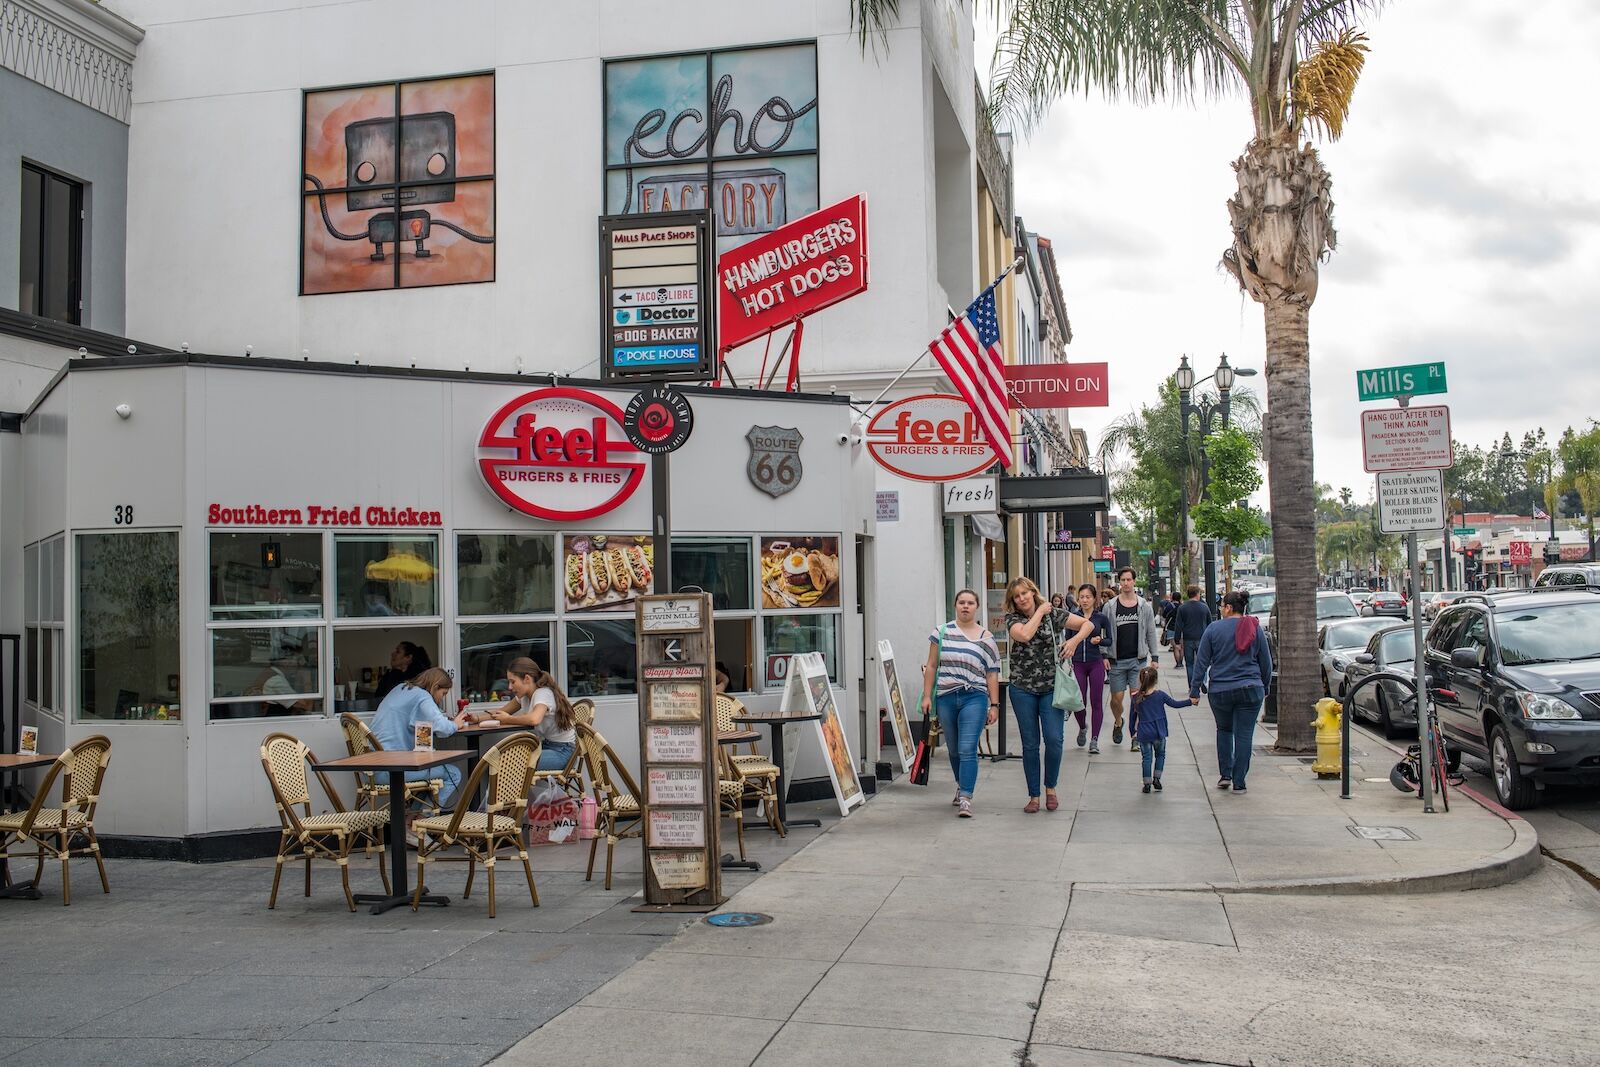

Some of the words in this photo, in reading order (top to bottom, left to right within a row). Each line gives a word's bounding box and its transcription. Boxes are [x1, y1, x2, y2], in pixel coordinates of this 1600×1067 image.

[626, 74, 816, 158] echo
[614, 232, 639, 244] MILLS
[640, 231, 666, 243] PLACE
[667, 229, 695, 241] SHOPS
[724, 217, 857, 293] HAMBURGERS
[741, 281, 785, 317] HOT
[789, 254, 854, 297] DOGS
[636, 291, 656, 302] TACO
[668, 289, 694, 300] LIBRE
[624, 329, 648, 342] DOG
[651, 326, 699, 341] BAKERY
[626, 350, 656, 361] POKE
[659, 348, 696, 360] HOUSE
[1004, 377, 1069, 394] COTTON
[1075, 377, 1100, 392] ON
[1361, 370, 1415, 395] Mills
[1429, 365, 1440, 378] PL
[624, 393, 645, 426] FIGHT
[652, 389, 689, 424] ACADEMY
[1367, 413, 1388, 422] HANG
[1389, 412, 1404, 420] OUT
[1405, 411, 1428, 419] AFTER
[1430, 410, 1443, 418] TEN
[895, 411, 974, 444] feel
[1383, 421, 1405, 430] THINK
[1407, 419, 1429, 428] AGAIN
[514, 413, 607, 463] feel
[1371, 432, 1398, 440] PASADENA
[1399, 430, 1426, 438] MUNICIPAL
[755, 437, 797, 450] ROUTE
[884, 446, 938, 455] BURGERS
[942, 446, 949, 455] &
[952, 446, 985, 456] FRIES
[755, 453, 796, 485] 66
[499, 471, 564, 483] BURGERS
[569, 472, 578, 483] &
[583, 472, 621, 484] FRIES
[1381, 475, 1437, 487] SKATEBOARDING
[947, 484, 994, 506] fresh
[1382, 487, 1408, 496] ROLLER
[1409, 486, 1439, 495] SKATING
[1384, 498, 1410, 507] ROLLER
[1412, 496, 1439, 505] BLADES
[114, 505, 134, 525] 38
[208, 503, 303, 526] Southern
[307, 505, 361, 526] Fried
[366, 506, 443, 526] Chicken
[1391, 507, 1433, 516] PROHIBITED
[1514, 542, 1525, 555] 21
[645, 666, 673, 678] Happy
[653, 684, 678, 694] MONDAY
[670, 726, 696, 736] TUESDAY
[666, 770, 701, 780] WEDNESDAY
[528, 801, 574, 820] VANS
[672, 812, 700, 821] THURSDAY
[554, 820, 579, 828] WALL
